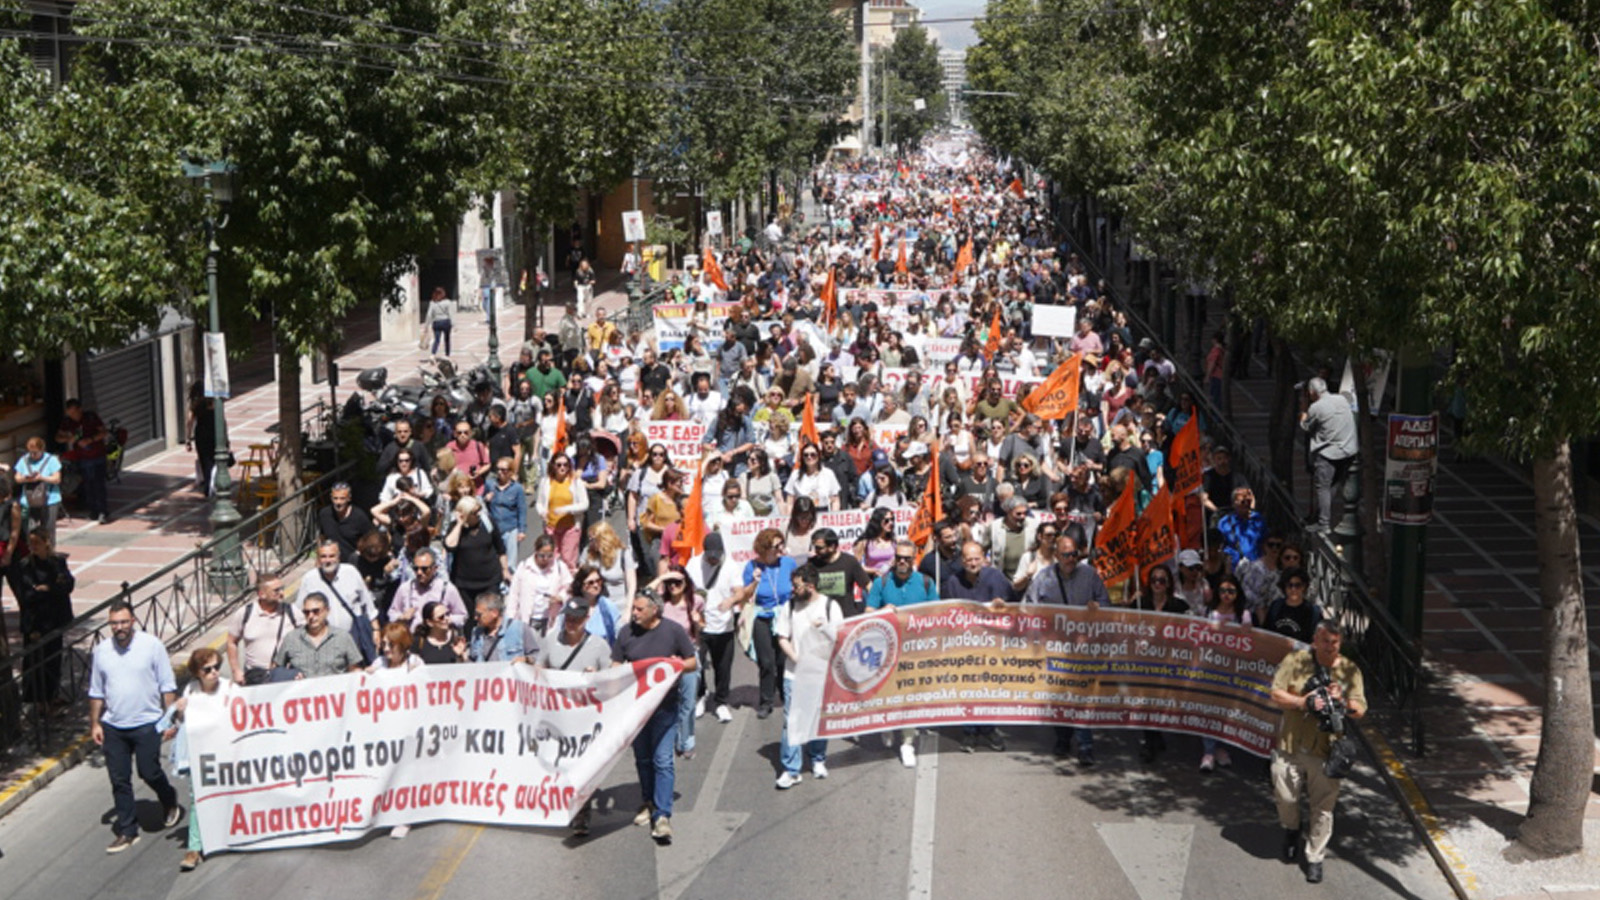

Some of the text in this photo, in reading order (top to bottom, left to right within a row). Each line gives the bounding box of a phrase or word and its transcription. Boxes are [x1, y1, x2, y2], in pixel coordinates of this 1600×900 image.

[731, 520, 764, 535] ΔΩΣΤΕ
[821, 511, 862, 527] ΠΑΙΔΕΙΑ
[906, 608, 1012, 633] Αγωνιζόμαστε
[1016, 616, 1047, 632] για:
[1054, 613, 1156, 639] Πραγματικές
[1163, 621, 1253, 652] αυξήσεις
[849, 641, 884, 673] ΔΟΕ
[897, 653, 1042, 673] Να αποσυρθεί ο νόμος
[902, 637, 938, 653] στους
[941, 631, 996, 652] μισθούς
[1001, 636, 1027, 652] μας
[1046, 639, 1128, 660] επαναφορά
[1133, 640, 1167, 658] 13ου
[1171, 647, 1193, 660] και
[1199, 648, 1230, 667] 14ου
[1235, 658, 1279, 678] μισθο
[1051, 661, 1109, 673] Υπογραφή
[1111, 661, 1174, 675] Συλλογικής
[896, 677, 915, 690] για
[918, 675, 933, 685] το
[936, 672, 959, 684] νέο
[961, 670, 1035, 686] πειθαρχικό
[224, 694, 274, 732] Όχι
[283, 692, 346, 724] στην
[356, 675, 418, 723] άρση
[426, 680, 466, 711] της
[826, 686, 1276, 734] Σύγχρονα και ασφαλή σχολεία με αποκλειστικά κρατική χρηματοδότηση
[199, 730, 356, 787] Επαναφορά
[364, 738, 404, 768] του
[415, 723, 458, 758] 13ου
[465, 728, 505, 757] και
[229, 786, 364, 835] Απαιτούμε
[514, 771, 577, 820] αυξήσ
